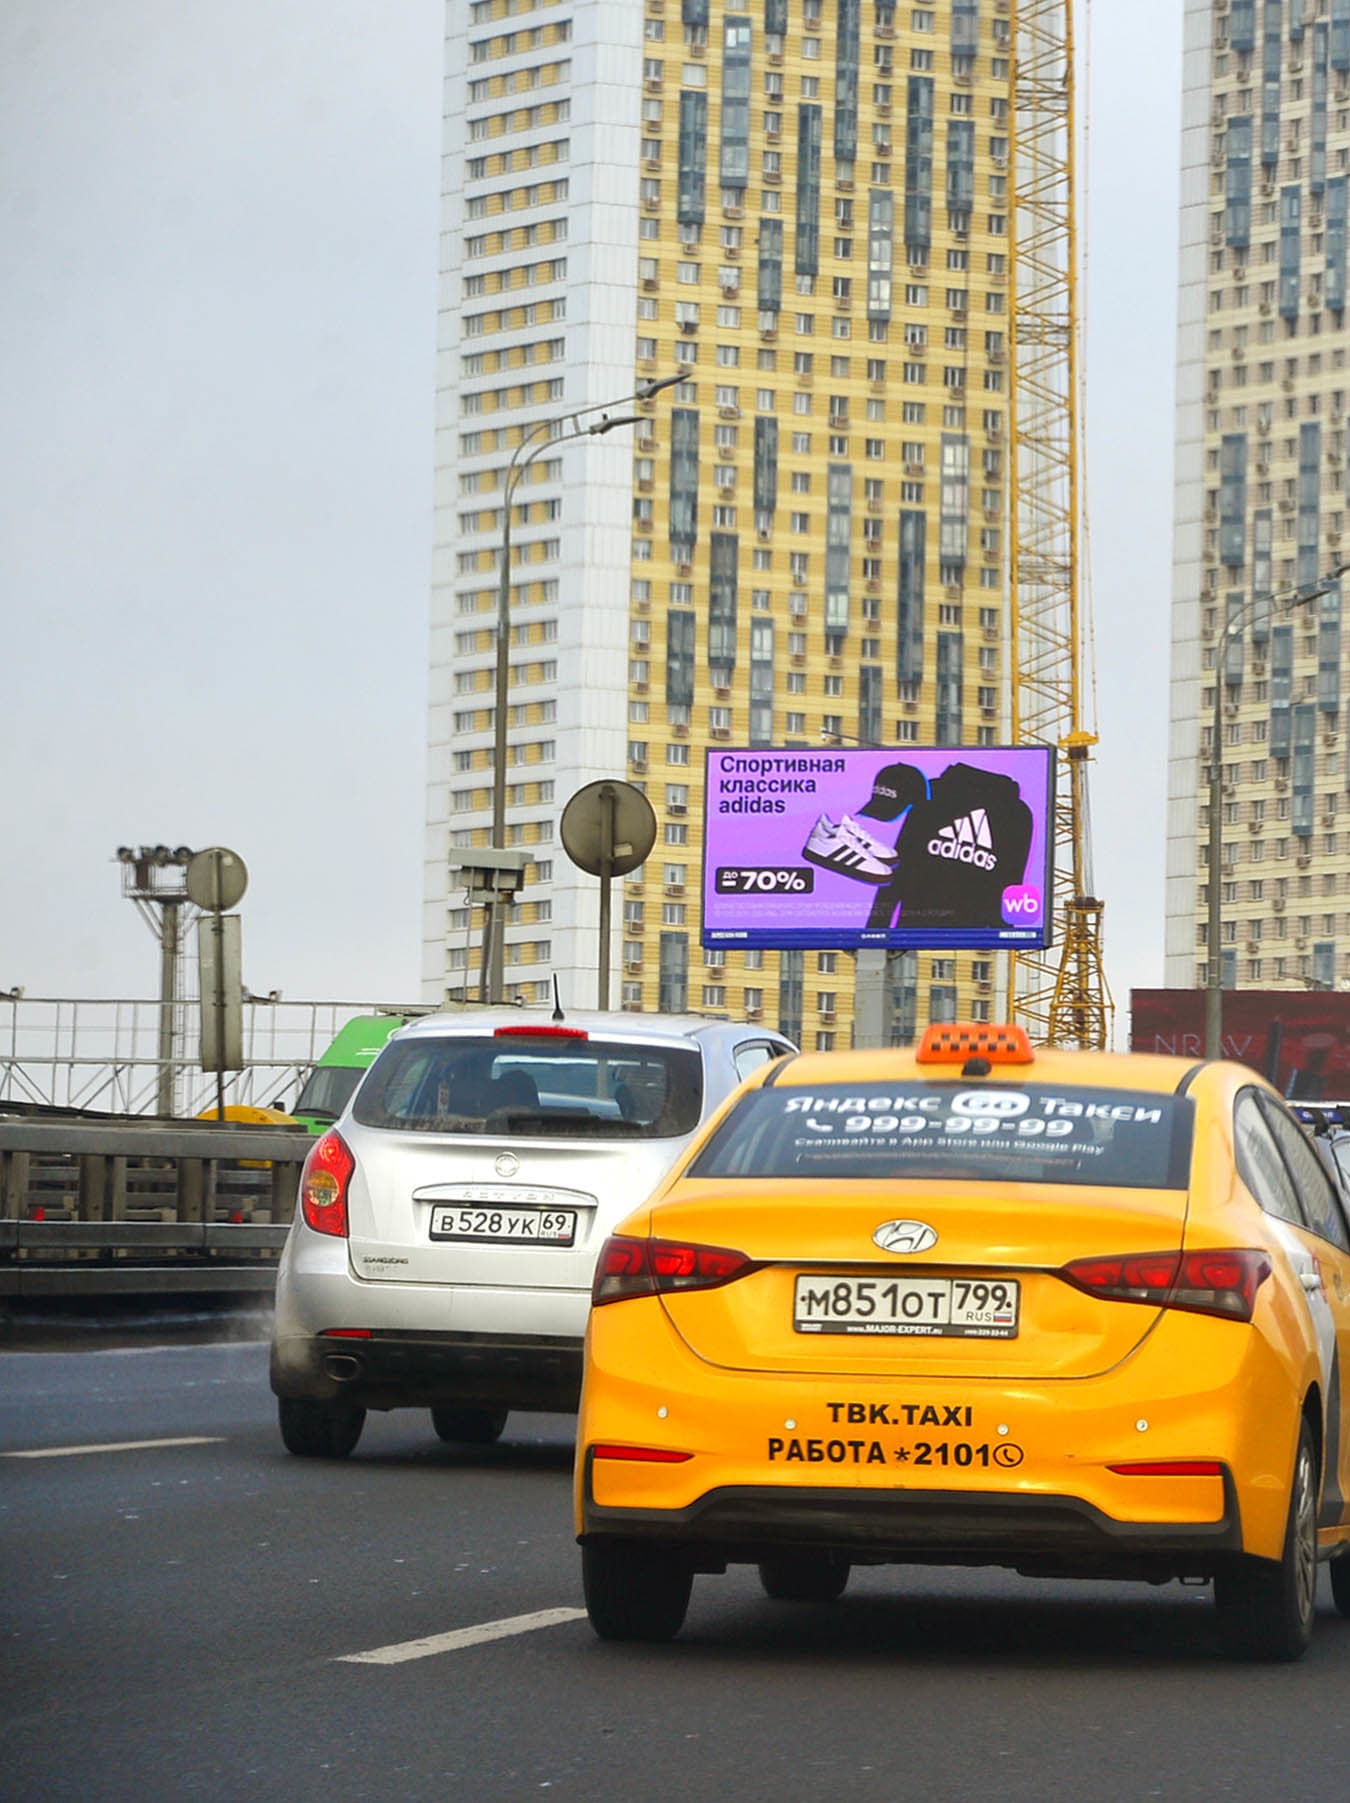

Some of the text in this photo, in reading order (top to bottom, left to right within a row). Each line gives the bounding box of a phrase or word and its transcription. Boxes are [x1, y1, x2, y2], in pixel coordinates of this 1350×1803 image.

[720, 756, 845, 776] Спортивная
[719, 778, 816, 793] классика
[719, 796, 785, 813] adidas
[927, 837, 998, 872] adidas
[1004, 893, 1038, 913] wb
[784, 1096, 942, 1113] Яндекс
[1039, 1097, 1162, 1124] Такси
[845, 1115, 1074, 1137] 999-99-99
[542, 1214, 567, 1231] 69
[807, 1282, 1008, 1318] М851ОТ 799
[966, 1311, 992, 1322] RUS
[768, 1438, 886, 1464] РАБОТА
